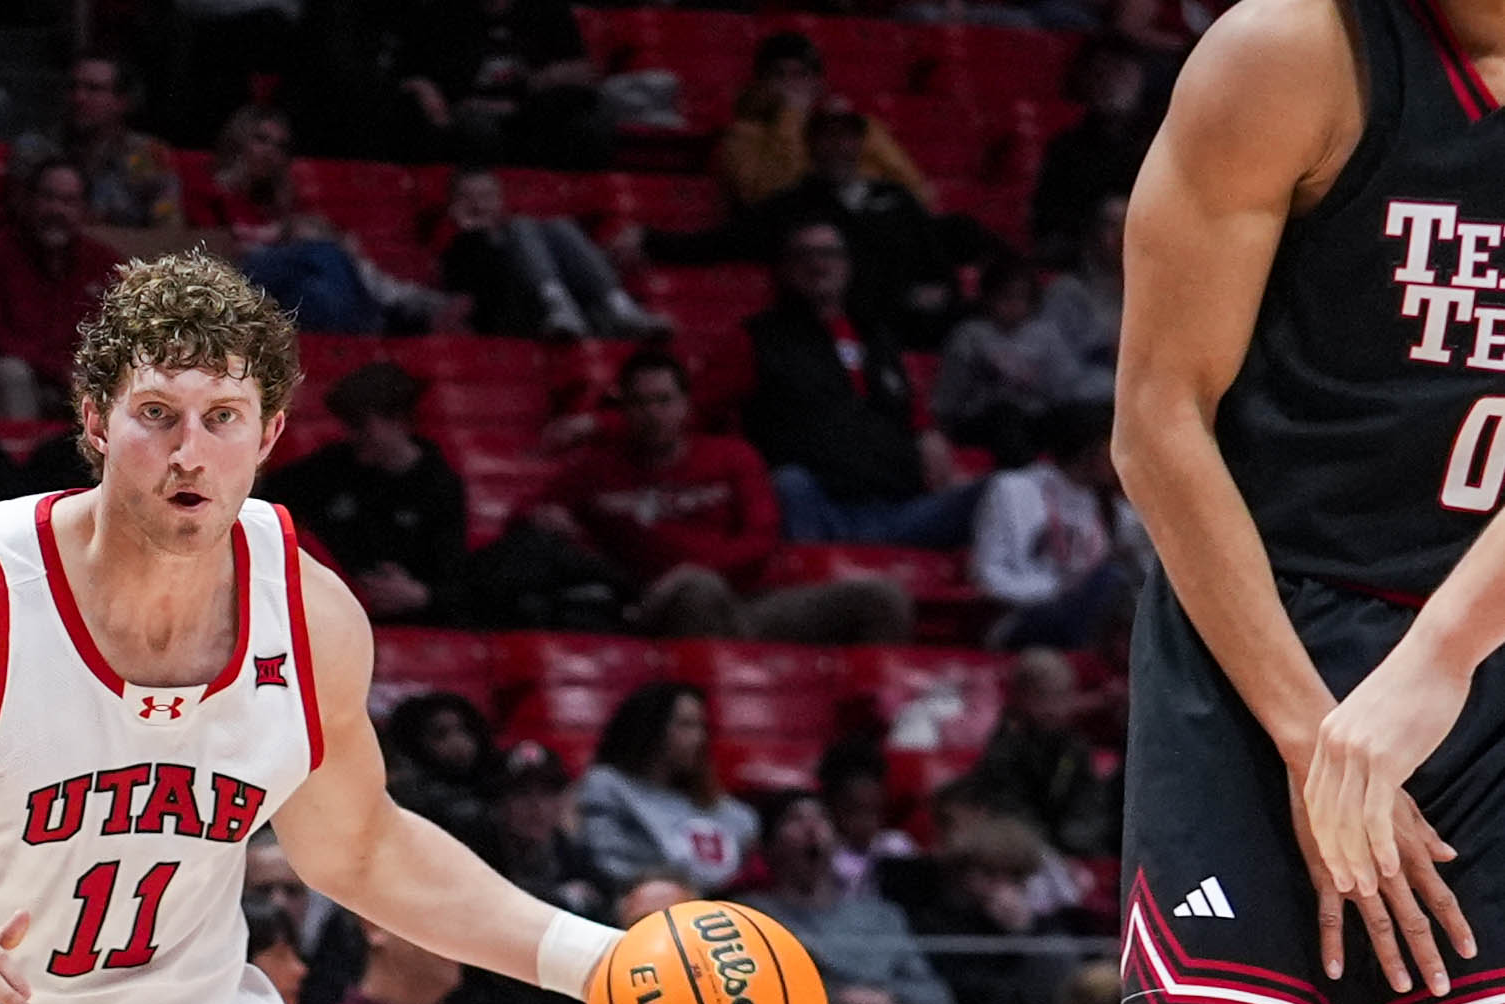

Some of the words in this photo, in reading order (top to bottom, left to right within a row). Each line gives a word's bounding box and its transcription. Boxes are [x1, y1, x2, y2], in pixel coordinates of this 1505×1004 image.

[1383, 197, 1505, 291] TE
[1438, 394, 1505, 515] 0
[23, 762, 267, 846] UTAH
[46, 859, 181, 977] 11
